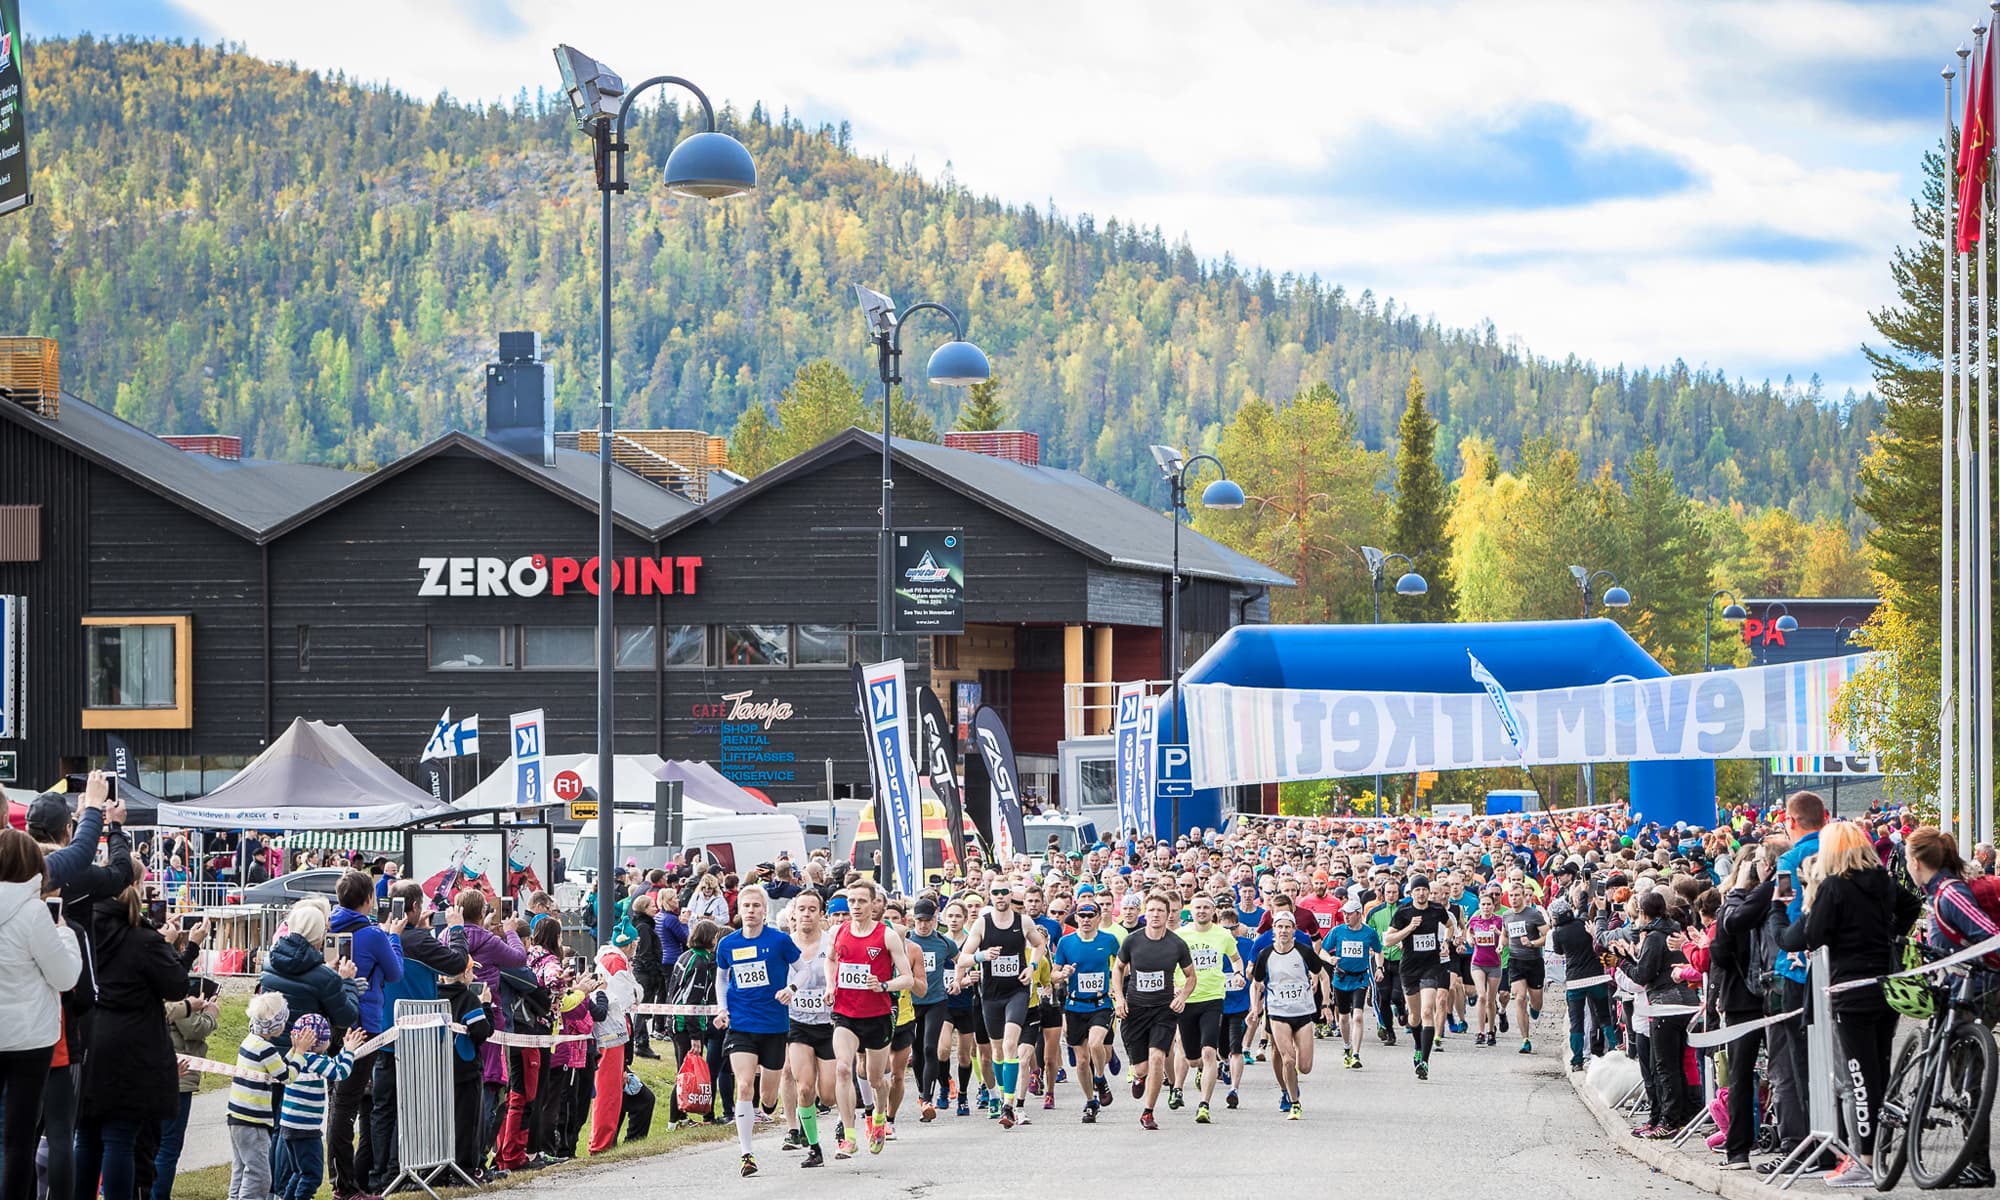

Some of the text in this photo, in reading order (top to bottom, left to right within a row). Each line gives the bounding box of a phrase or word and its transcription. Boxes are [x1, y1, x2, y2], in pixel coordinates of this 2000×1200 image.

[722, 690, 793, 730] Tanja
[723, 724, 759, 734] SHOP
[723, 736, 771, 745] RENTAL
[924, 713, 956, 789] FAST
[723, 752, 795, 762] LIFTPASSES
[977, 728, 1019, 808] FAST
[1165, 749, 1188, 777] P
[723, 771, 795, 781] SKISERVICE
[557, 778, 579, 793] R1
[1194, 955, 1217, 966] 1214
[993, 962, 1018, 972] 1860
[737, 970, 766, 984] 1288
[839, 971, 867, 985] 1063
[1080, 979, 1103, 989] 1082
[1138, 978, 1163, 988] 1750
[1279, 989, 1303, 999] 1137
[793, 997, 822, 1009] 1303
[1848, 1058, 1871, 1137] adidas
